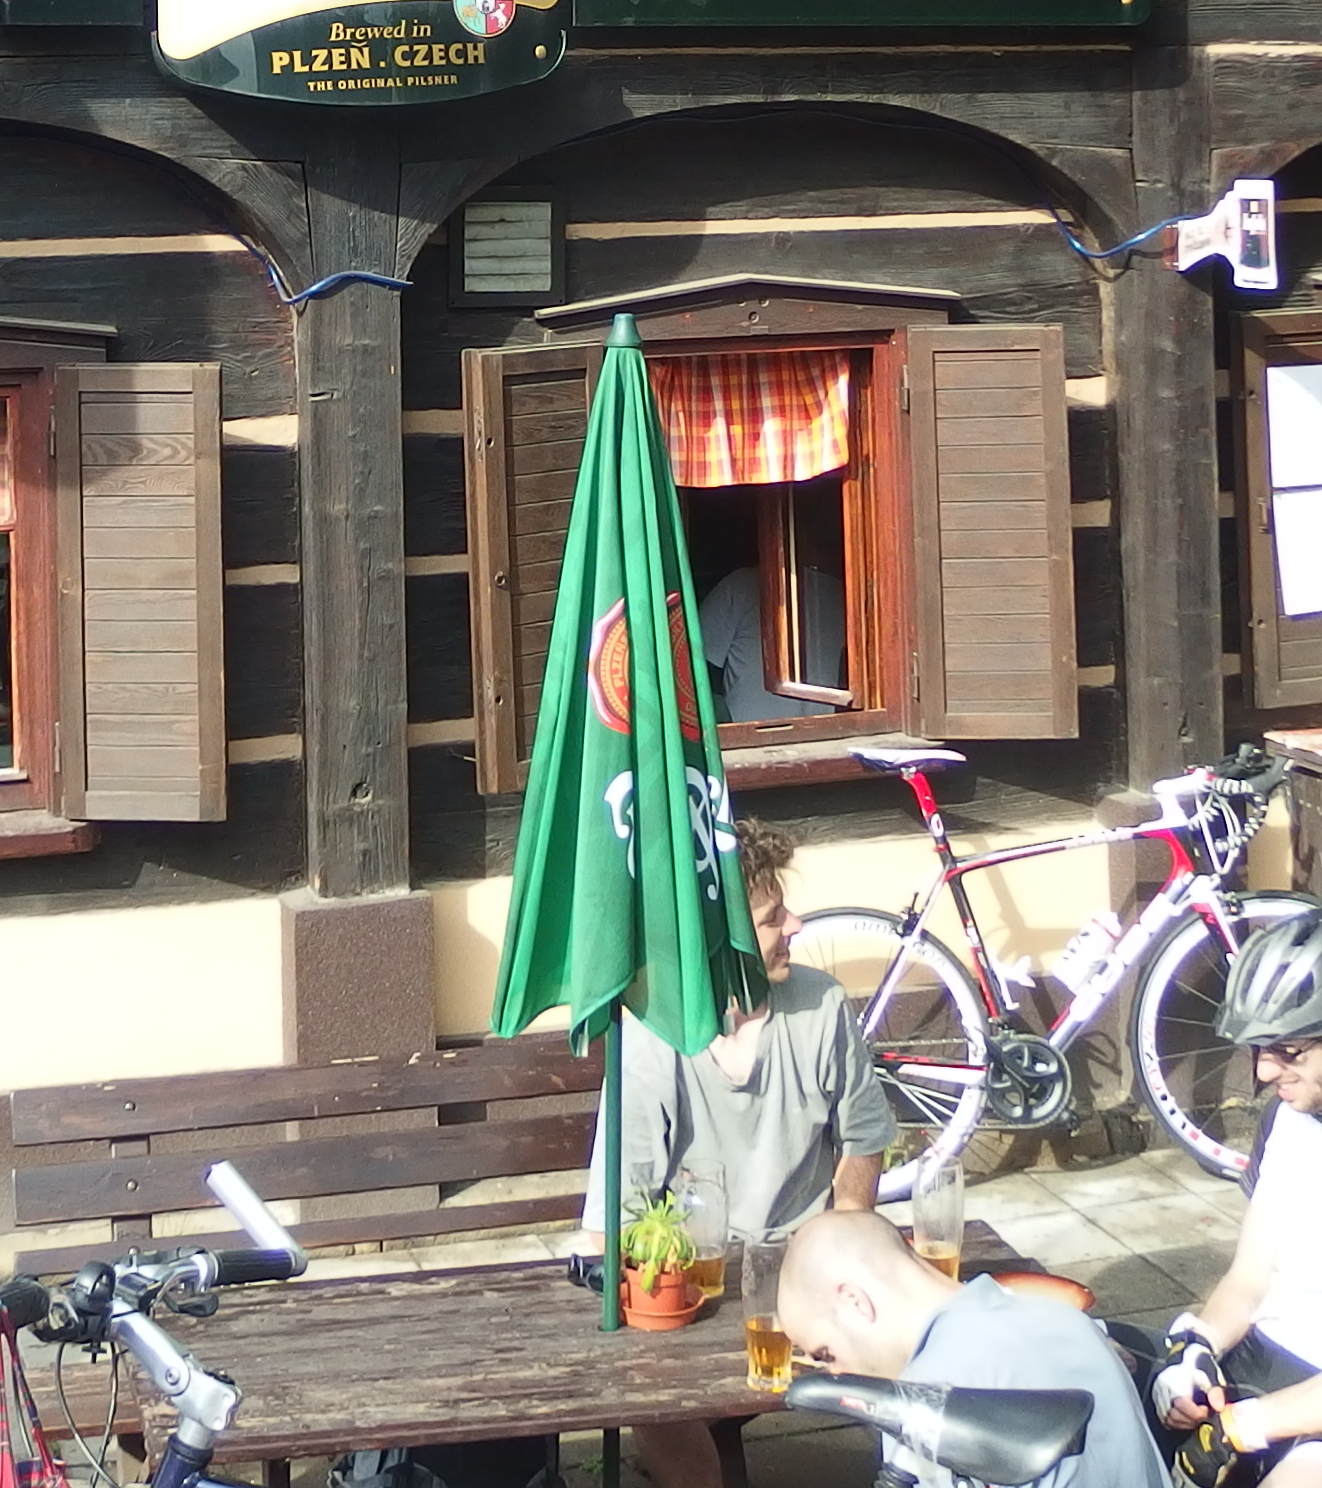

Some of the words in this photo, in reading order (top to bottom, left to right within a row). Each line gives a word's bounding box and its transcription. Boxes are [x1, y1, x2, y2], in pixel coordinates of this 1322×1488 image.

[329, 20, 406, 42] Brewed
[412, 19, 432, 38] in
[271, 41, 371, 74] PLZEŇ
[393, 42, 486, 68] CZECH
[307, 81, 333, 92] THE
[337, 76, 403, 90] ORIGINAL
[408, 74, 459, 87] PILSNER
